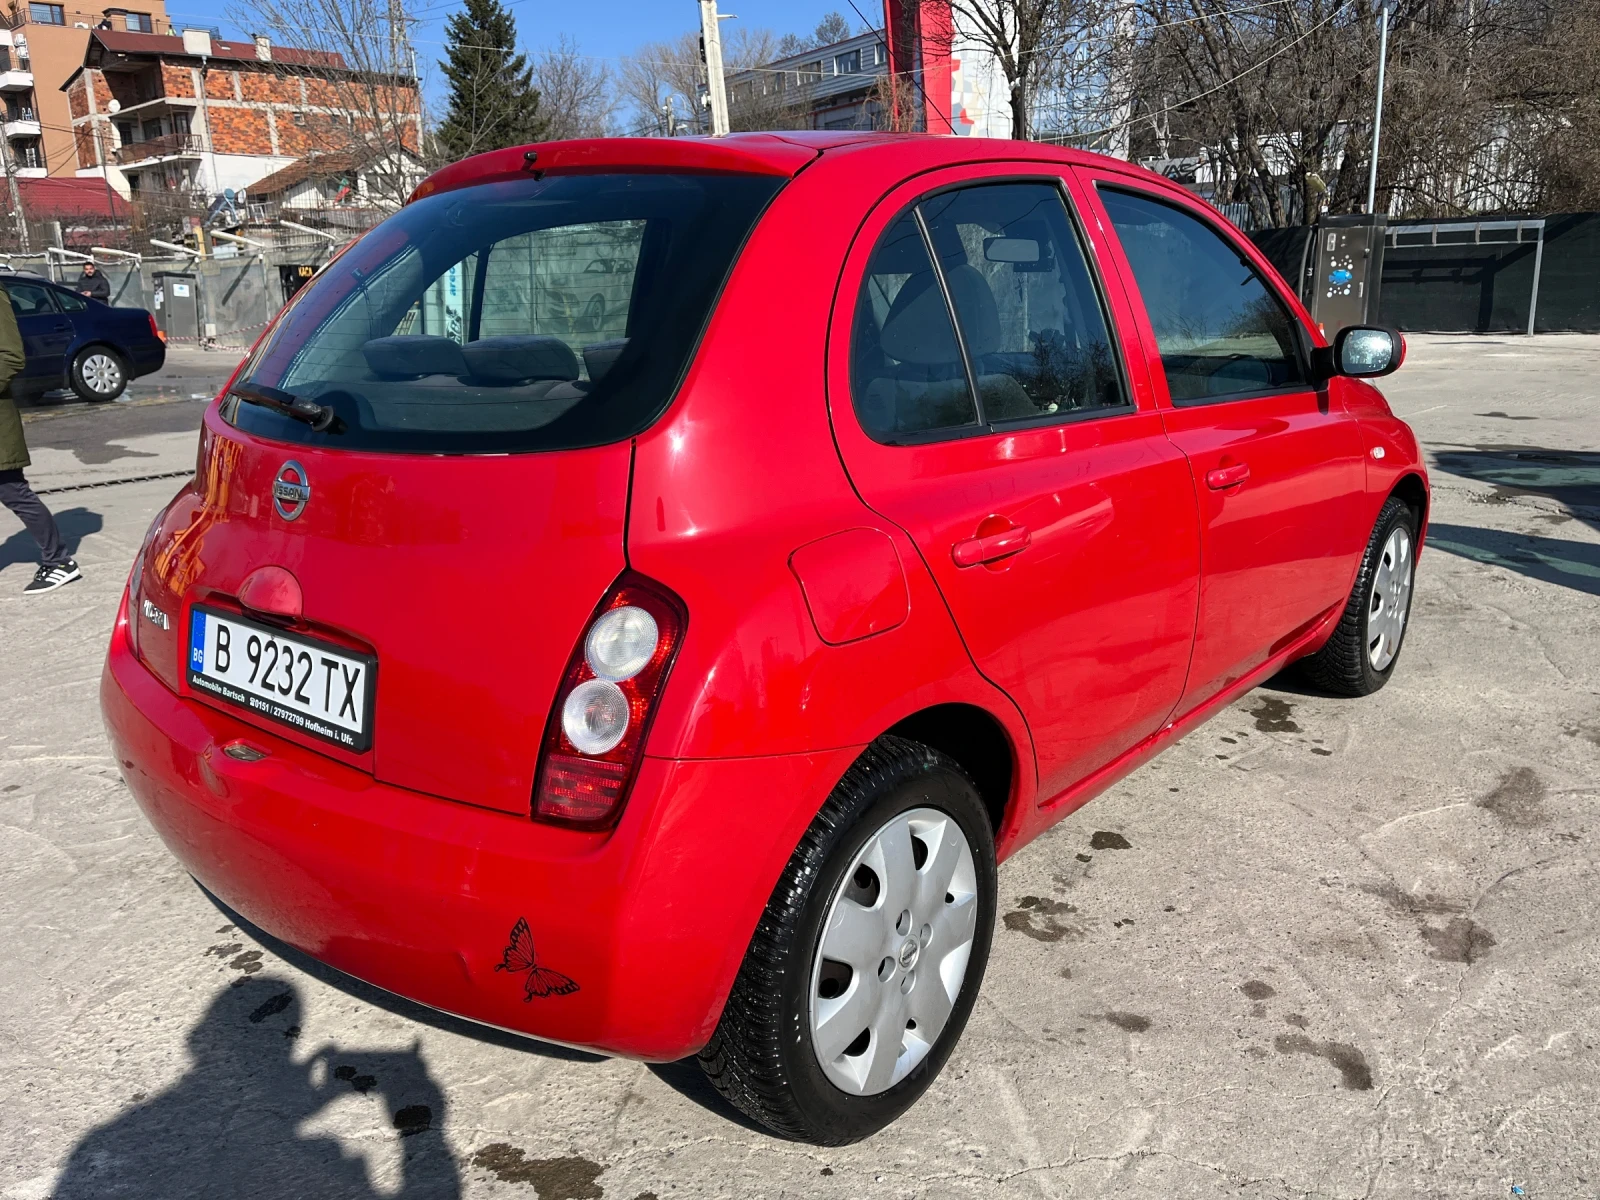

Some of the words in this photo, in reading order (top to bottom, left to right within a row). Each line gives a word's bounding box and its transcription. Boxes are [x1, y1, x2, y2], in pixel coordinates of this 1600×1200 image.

[193, 648, 203, 663] BG
[215, 623, 231, 673] B
[247, 634, 313, 705] 9232
[321, 657, 360, 722] TX
[192, 674, 222, 694] Automobile
[222, 687, 245, 702] Bartsch
[273, 706, 304, 726] 27972799
[305, 718, 333, 738] Hofheim
